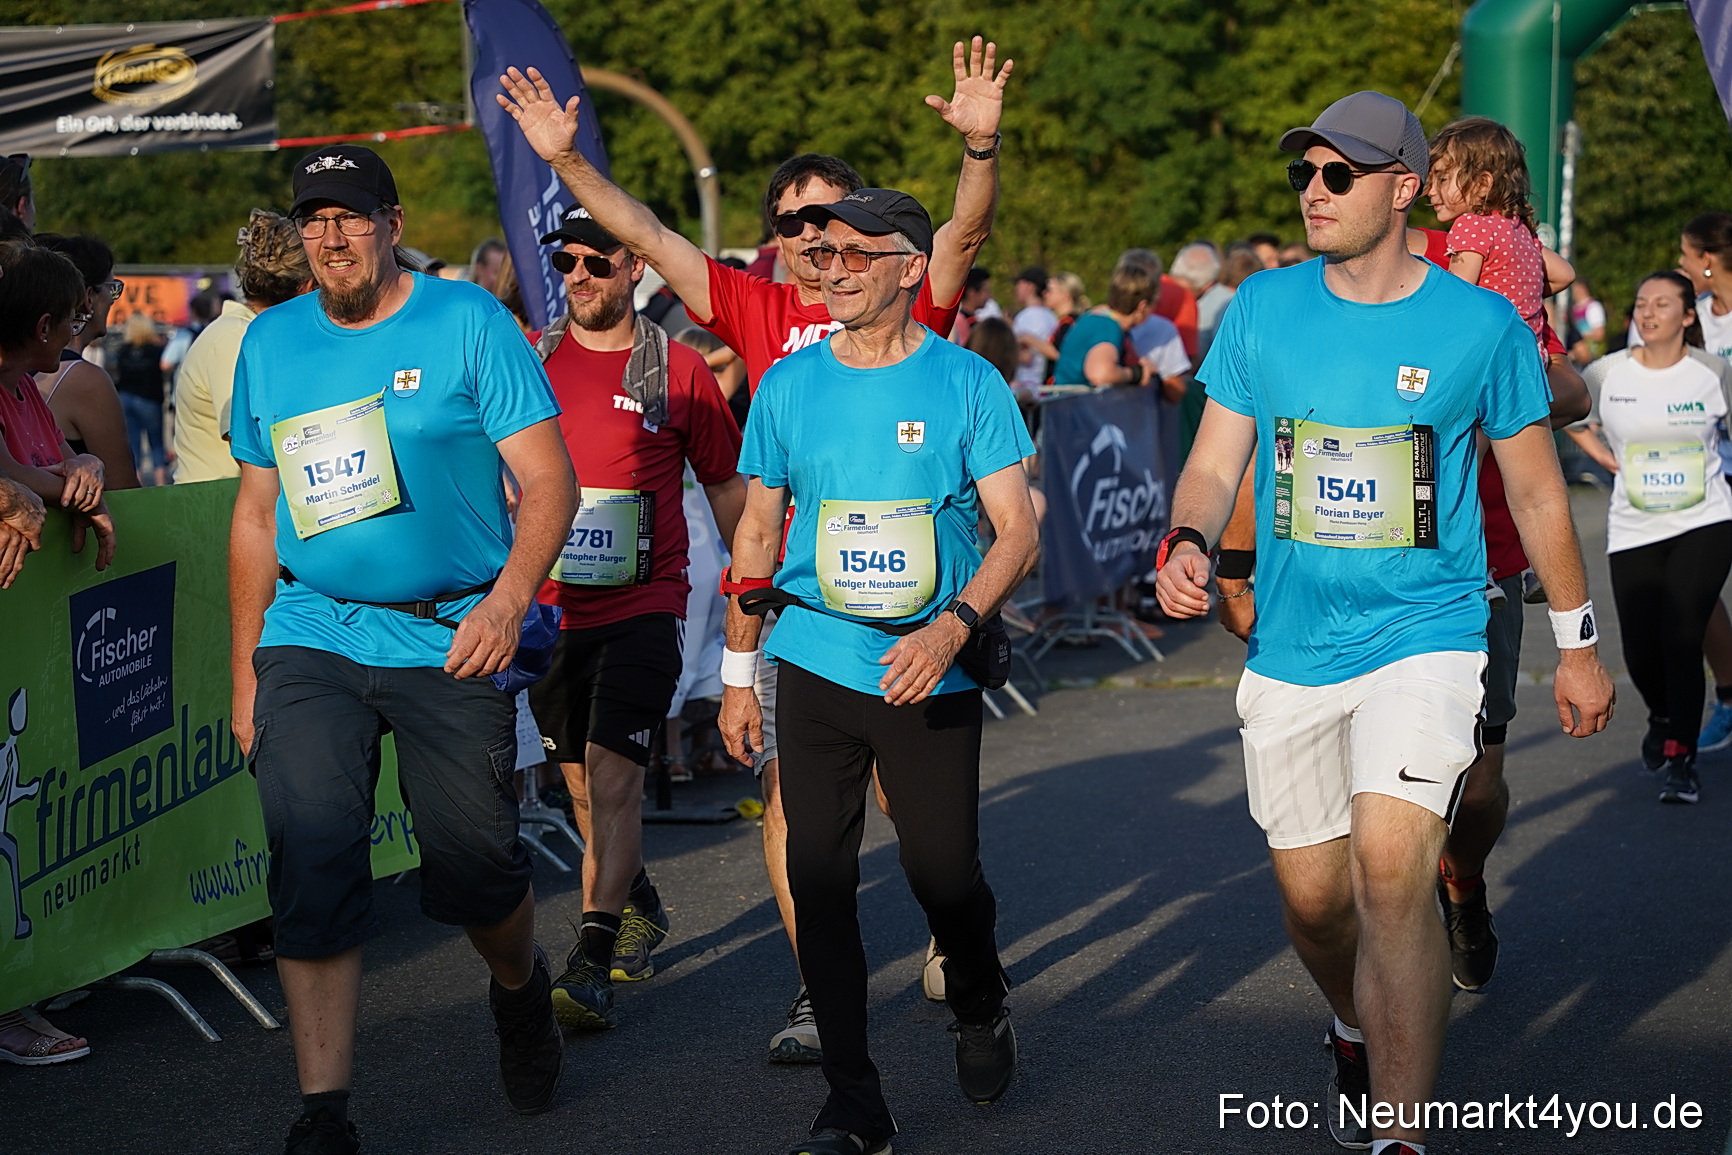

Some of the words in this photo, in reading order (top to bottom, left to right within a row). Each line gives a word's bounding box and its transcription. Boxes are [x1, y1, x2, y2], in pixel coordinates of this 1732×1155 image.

[56, 115, 84, 133] Ein
[120, 113, 151, 132] der
[1667, 402, 1694, 413] LVM
[1277, 426, 1292, 434] AOK
[1318, 449, 1353, 458] Firmenlauf
[304, 450, 366, 487] 1547
[1414, 468, 1420, 478] 20
[1642, 472, 1685, 486] 1530
[305, 489, 339, 506] Martin
[340, 474, 381, 496] Schrödel
[1317, 475, 1376, 502] 1541
[1086, 469, 1166, 532] Fisch
[1315, 506, 1350, 518] Florian
[1352, 509, 1384, 521] Beyer
[1418, 503, 1427, 538] HILTL
[843, 523, 879, 531] Firmenlauf
[565, 528, 613, 549] 2781
[560, 551, 598, 562] ristopher
[599, 553, 627, 564] Burger
[840, 550, 906, 573] 1546
[834, 579, 866, 590] Holger
[868, 579, 918, 589] Neubauer
[91, 625, 158, 672] Fischer
[98, 653, 153, 688] AUTOMOBILE
[126, 689, 141, 707] das
[149, 691, 166, 713] mit!
[36, 703, 245, 875] firmenlau
[43, 834, 141, 919] neumarkt
